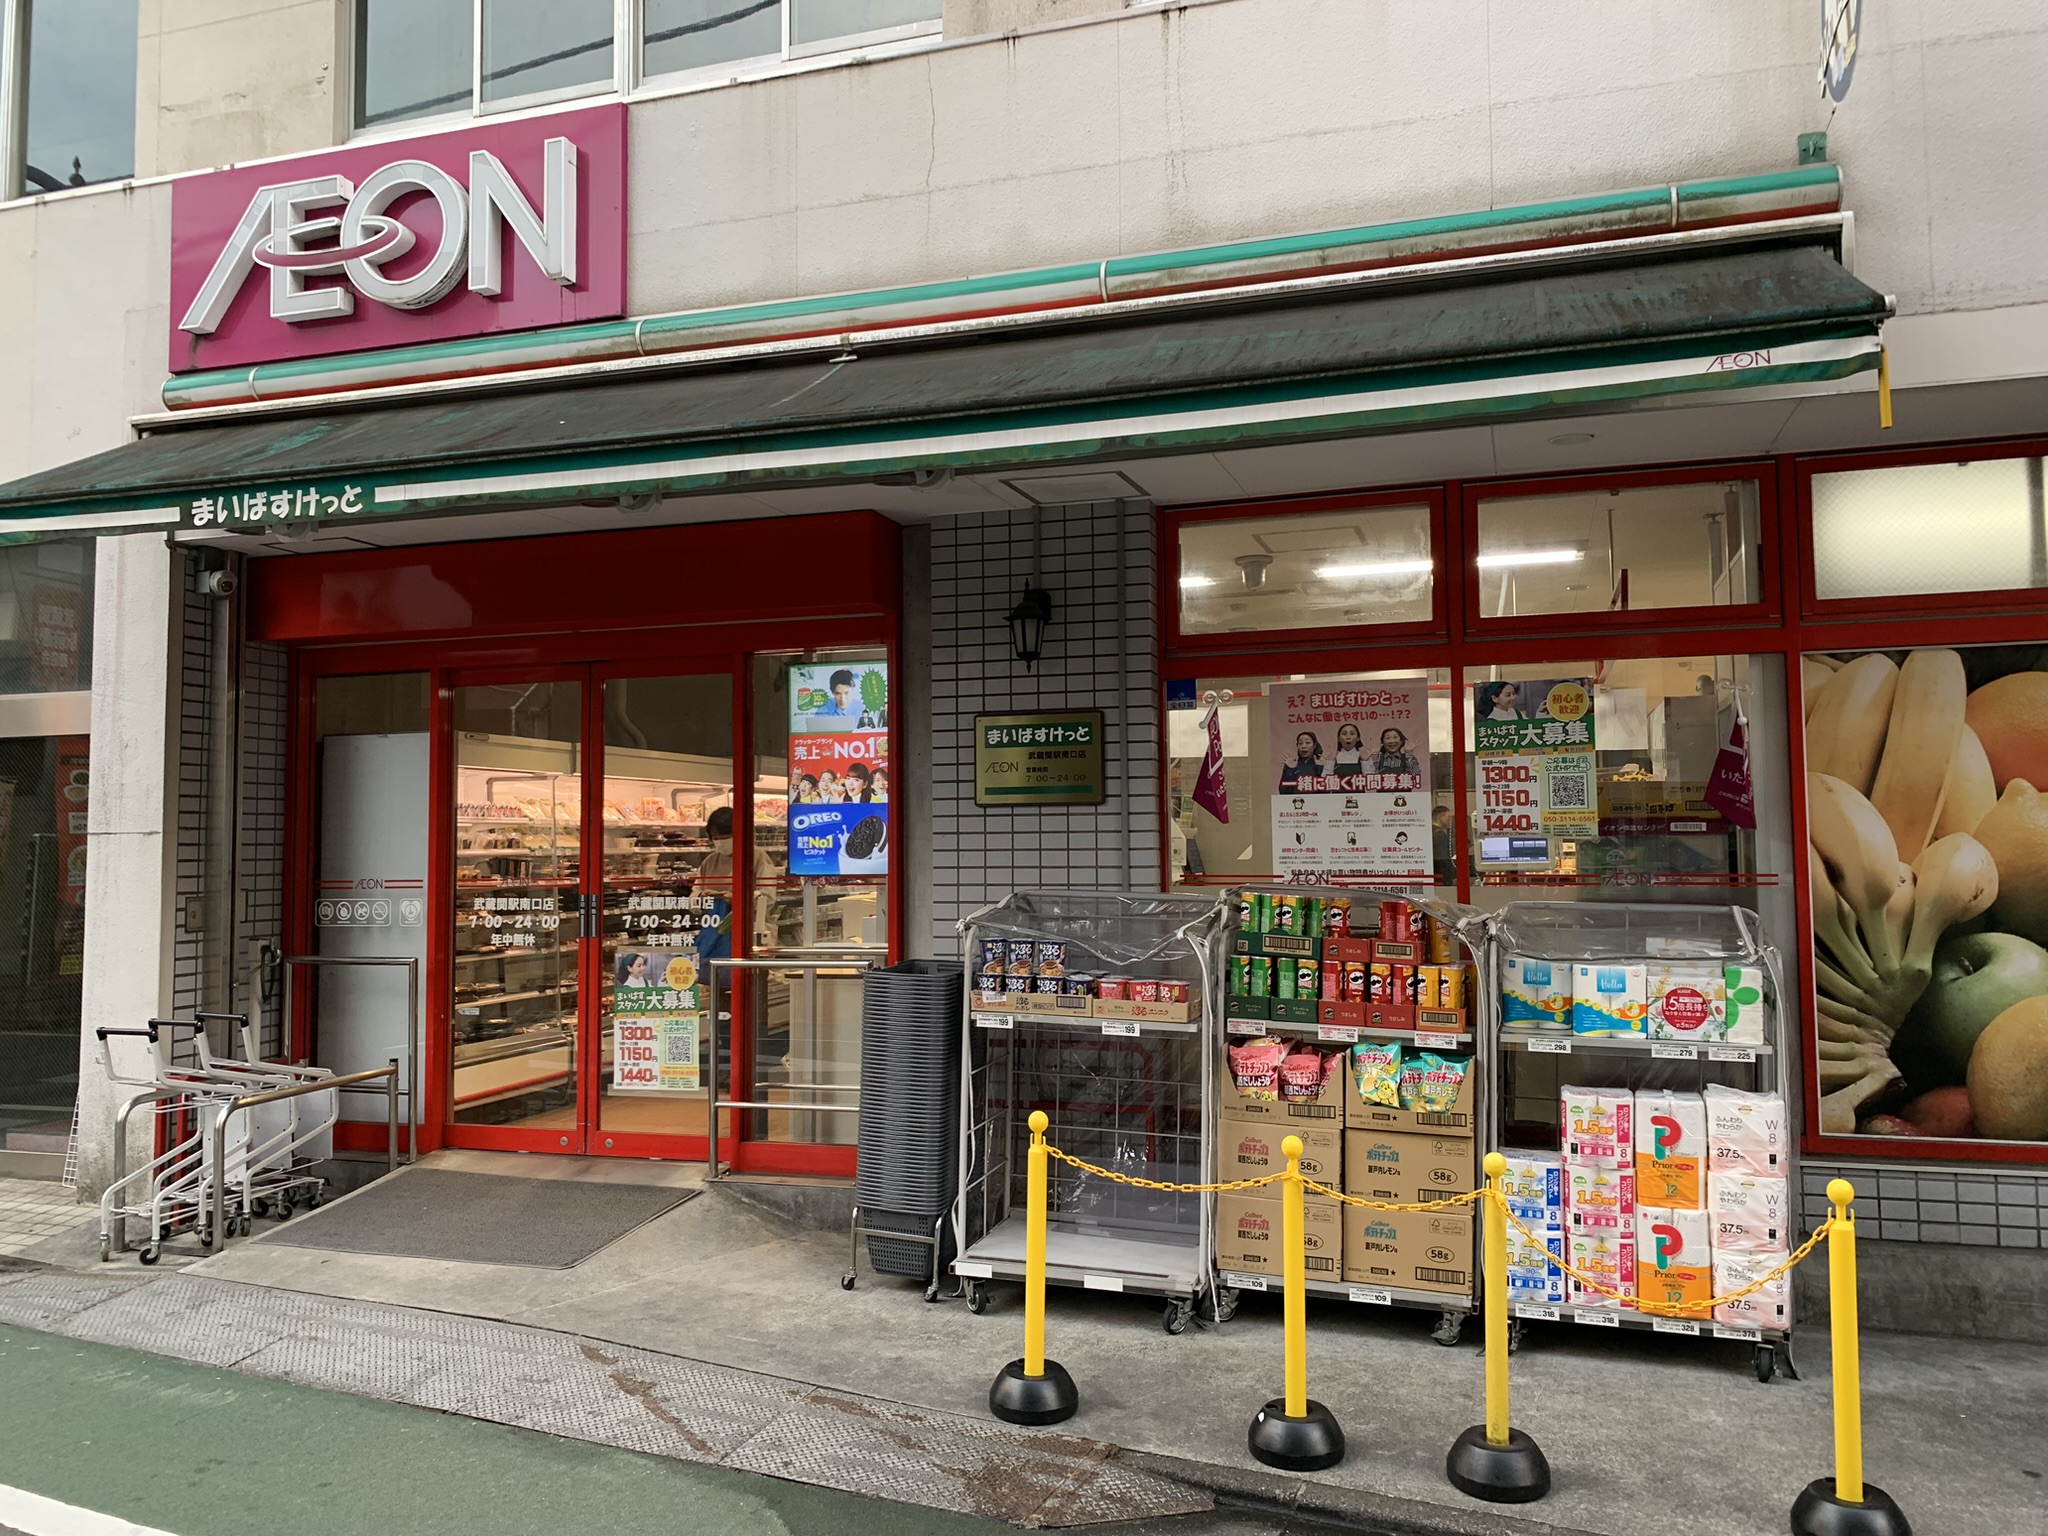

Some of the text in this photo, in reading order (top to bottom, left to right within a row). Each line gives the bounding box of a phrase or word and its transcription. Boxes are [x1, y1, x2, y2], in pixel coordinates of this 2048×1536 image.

[191, 484, 363, 526] まいばすけっと
[1552, 693, 1584, 705] 初心者
[1558, 705, 1580, 715] 歓迎
[987, 726, 1090, 745] まいばすけっと
[1478, 725, 1517, 737] まいばす
[1520, 721, 1590, 746] 大募集
[1480, 736, 1519, 748] スタッフ
[794, 737, 876, 760] 売上 NO.1
[1027, 750, 1087, 760] 武蔵関駅南口店
[1281, 773, 1422, 792] 一緒に働く仲間募集！
[793, 812, 842, 830] OREO
[809, 834, 834, 849] No.1
[473, 897, 555, 911] 武蔵関駅南口店
[627, 896, 715, 910] 武蔵関駅南口店
[491, 933, 536, 947] 年中無休
[646, 933, 695, 947] 年中無休
[670, 966, 693, 976] 初心者
[1527, 971, 1548, 982] Hello
[1601, 978, 1623, 990] Hello
[617, 991, 645, 1000] まいばす
[646, 990, 695, 1010] 大募集
[618, 1001, 646, 1010] スタッフ
[998, 1018, 1009, 1026] 199
[1124, 1025, 1136, 1034] 199
[1553, 1043, 1567, 1051] 298
[1679, 1049, 1693, 1057] 279
[1356, 1053, 1392, 1066] ポテトチップス
[1715, 1115, 1743, 1124] ふんわり
[1765, 1119, 1779, 1131] W
[1716, 1123, 1743, 1131] やわらか
[1244, 1136, 1263, 1144] Calbee
[1768, 1133, 1777, 1144] 8
[1238, 1142, 1269, 1156] ポテトチップス
[1373, 1142, 1392, 1150] Calbee
[1366, 1149, 1400, 1163] ポテトチップス
[1620, 1148, 1628, 1159] 8
[1300, 1161, 1318, 1172] 58g
[1652, 1160, 1674, 1169] Prior
[1433, 1171, 1452, 1182] 58g
[1666, 1183, 1678, 1195] 12
[1719, 1190, 1748, 1199] ふんわり
[1720, 1198, 1748, 1206] やわらか
[1766, 1194, 1779, 1205] W
[1244, 1211, 1263, 1219] Calbee
[1549, 1211, 1557, 1220] 8
[1768, 1208, 1777, 1218] 8
[1238, 1217, 1270, 1231] ポテトチップス
[1623, 1219, 1631, 1229] 8
[1364, 1226, 1397, 1240] ポテトチップス
[1430, 1249, 1449, 1260] 58g
[1654, 1270, 1676, 1279] Prior
[1251, 1280, 1263, 1288] 109
[1550, 1281, 1558, 1291] 8
[1776, 1284, 1784, 1294] 8
[1374, 1294, 1387, 1302] 109
[1542, 1310, 1555, 1318] 318
[1601, 1316, 1615, 1324] 318
[1681, 1324, 1695, 1332] 328
[1742, 1331, 1756, 1339] 378
